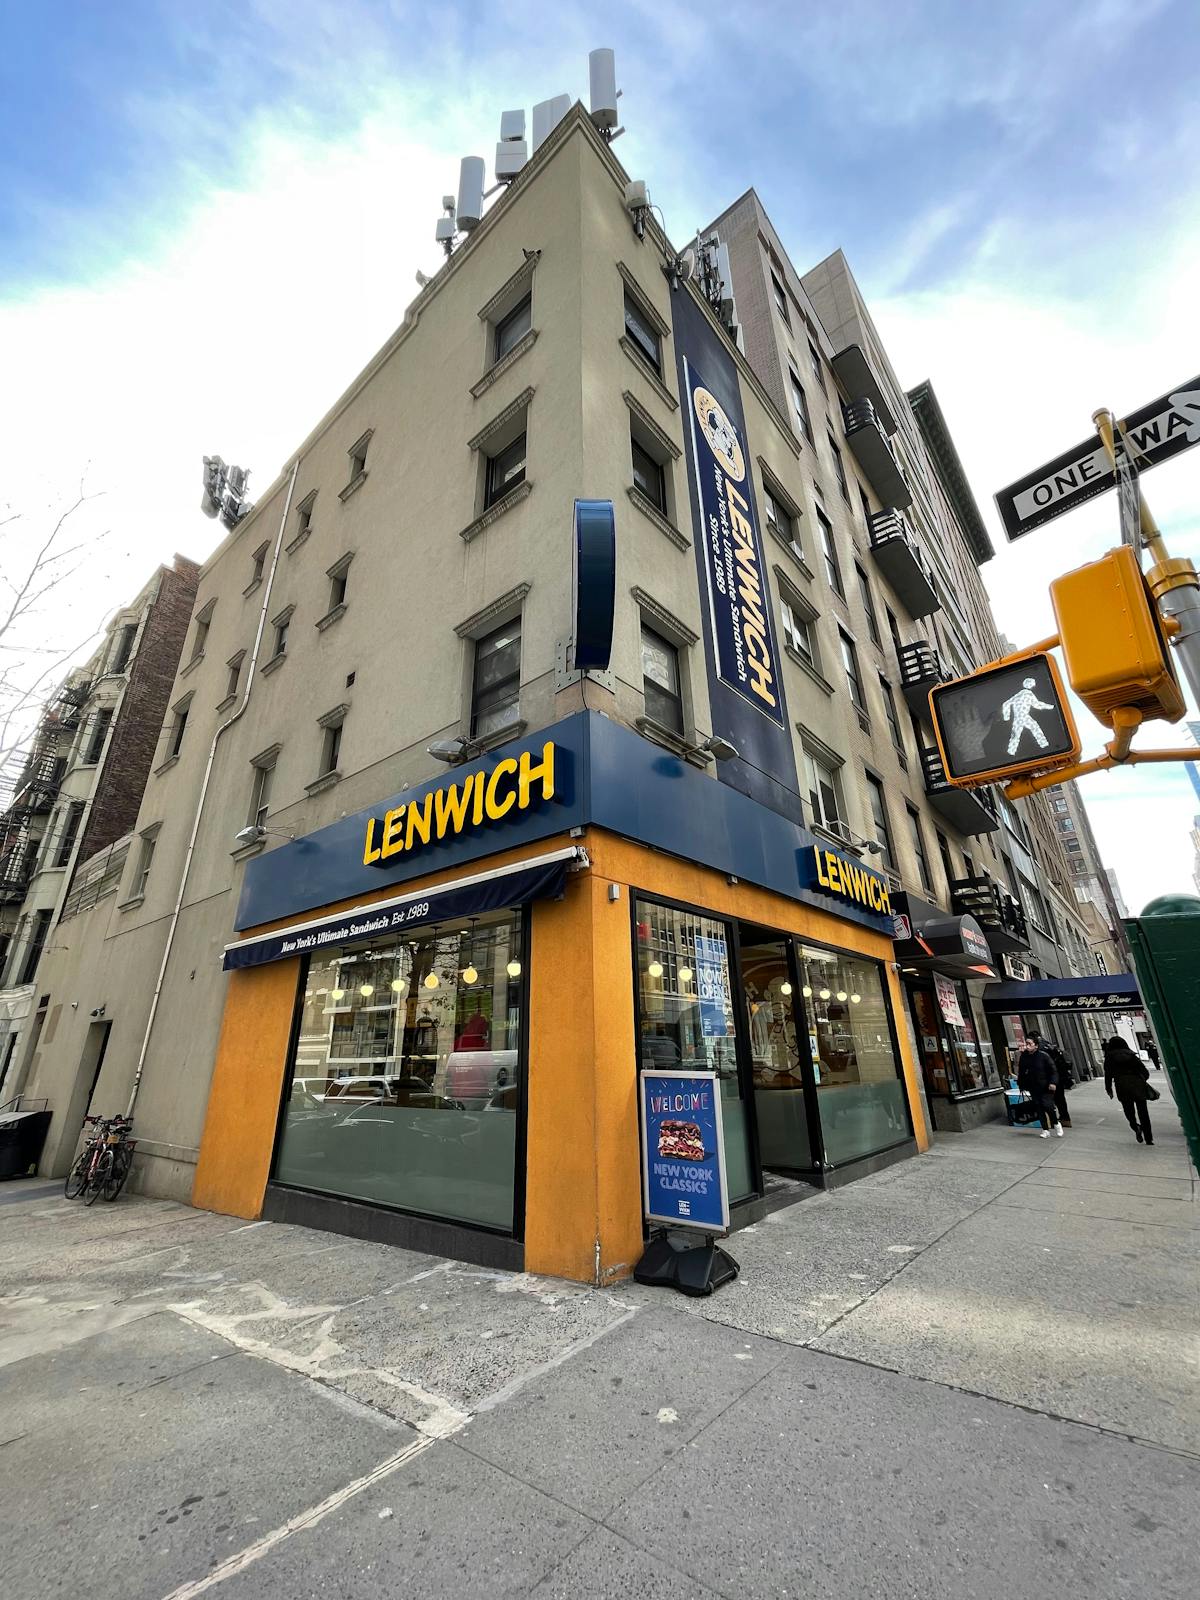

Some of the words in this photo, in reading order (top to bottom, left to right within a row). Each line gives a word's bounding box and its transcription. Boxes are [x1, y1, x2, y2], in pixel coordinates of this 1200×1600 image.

[714, 463, 723, 497] New
[1032, 456, 1102, 506] ONE
[710, 513, 720, 555] Since
[718, 497, 730, 538] York's
[714, 555, 726, 595] 1989
[723, 538, 736, 601] Ultimate
[725, 478, 776, 707] LENWICH
[730, 603, 747, 682] Sandwich
[363, 741, 555, 866] LENWICH
[814, 844, 891, 916] LENWICH
[281, 941, 296, 954] New
[295, 934, 317, 949] York's
[317, 927, 348, 944] Ultimate
[349, 915, 388, 936] Sandwich
[392, 911, 405, 925] Est
[406, 902, 429, 920] 1989
[699, 967, 722, 985] NOW
[701, 984, 724, 1000] OPEN
[1050, 998, 1074, 1007] Four
[1077, 996, 1104, 1008] Fifty
[1107, 994, 1131, 1004] Five
[927, 1038, 935, 1048] A
[650, 1092, 709, 1114] WELCOME
[653, 1162, 680, 1178] NEW
[682, 1166, 714, 1181] YORK
[660, 1176, 708, 1195] CLASSICS
